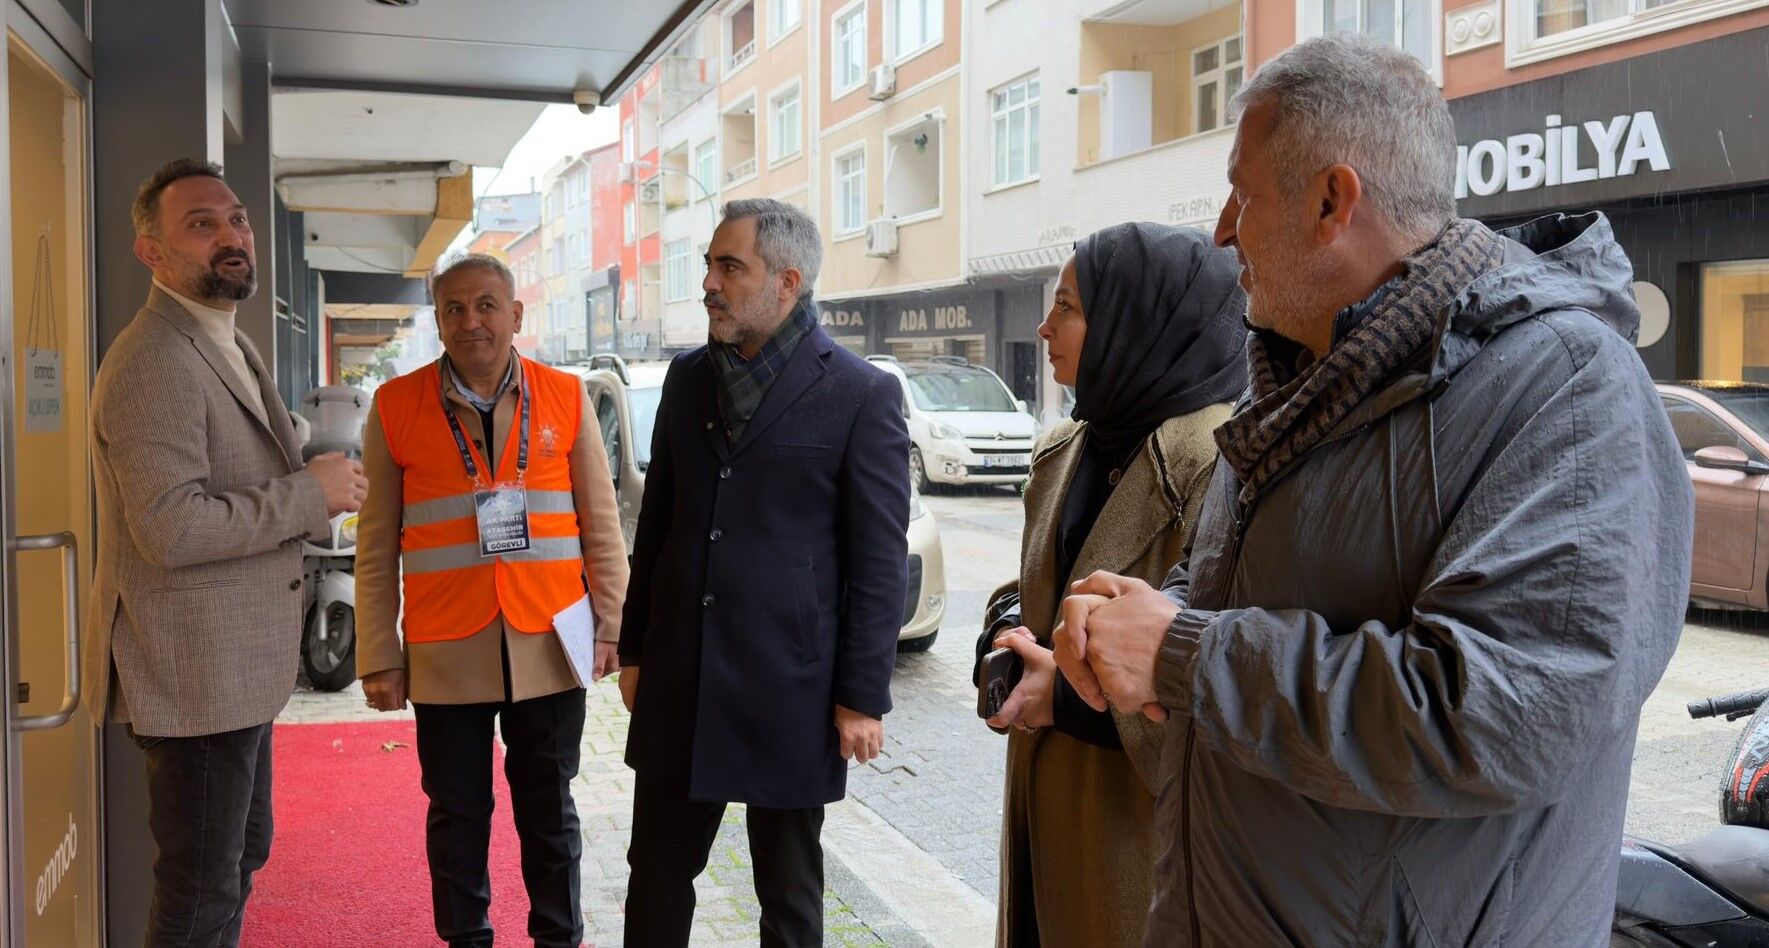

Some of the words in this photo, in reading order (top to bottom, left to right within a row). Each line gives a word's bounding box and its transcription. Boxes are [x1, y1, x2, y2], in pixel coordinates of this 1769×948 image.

[1455, 111, 1671, 200] OBİLYA
[820, 310, 864, 326] ADA
[900, 309, 928, 331] ADA
[935, 305, 972, 329] MOB.
[491, 540, 523, 550] GÖREVLİ
[36, 812, 77, 916] emmob
